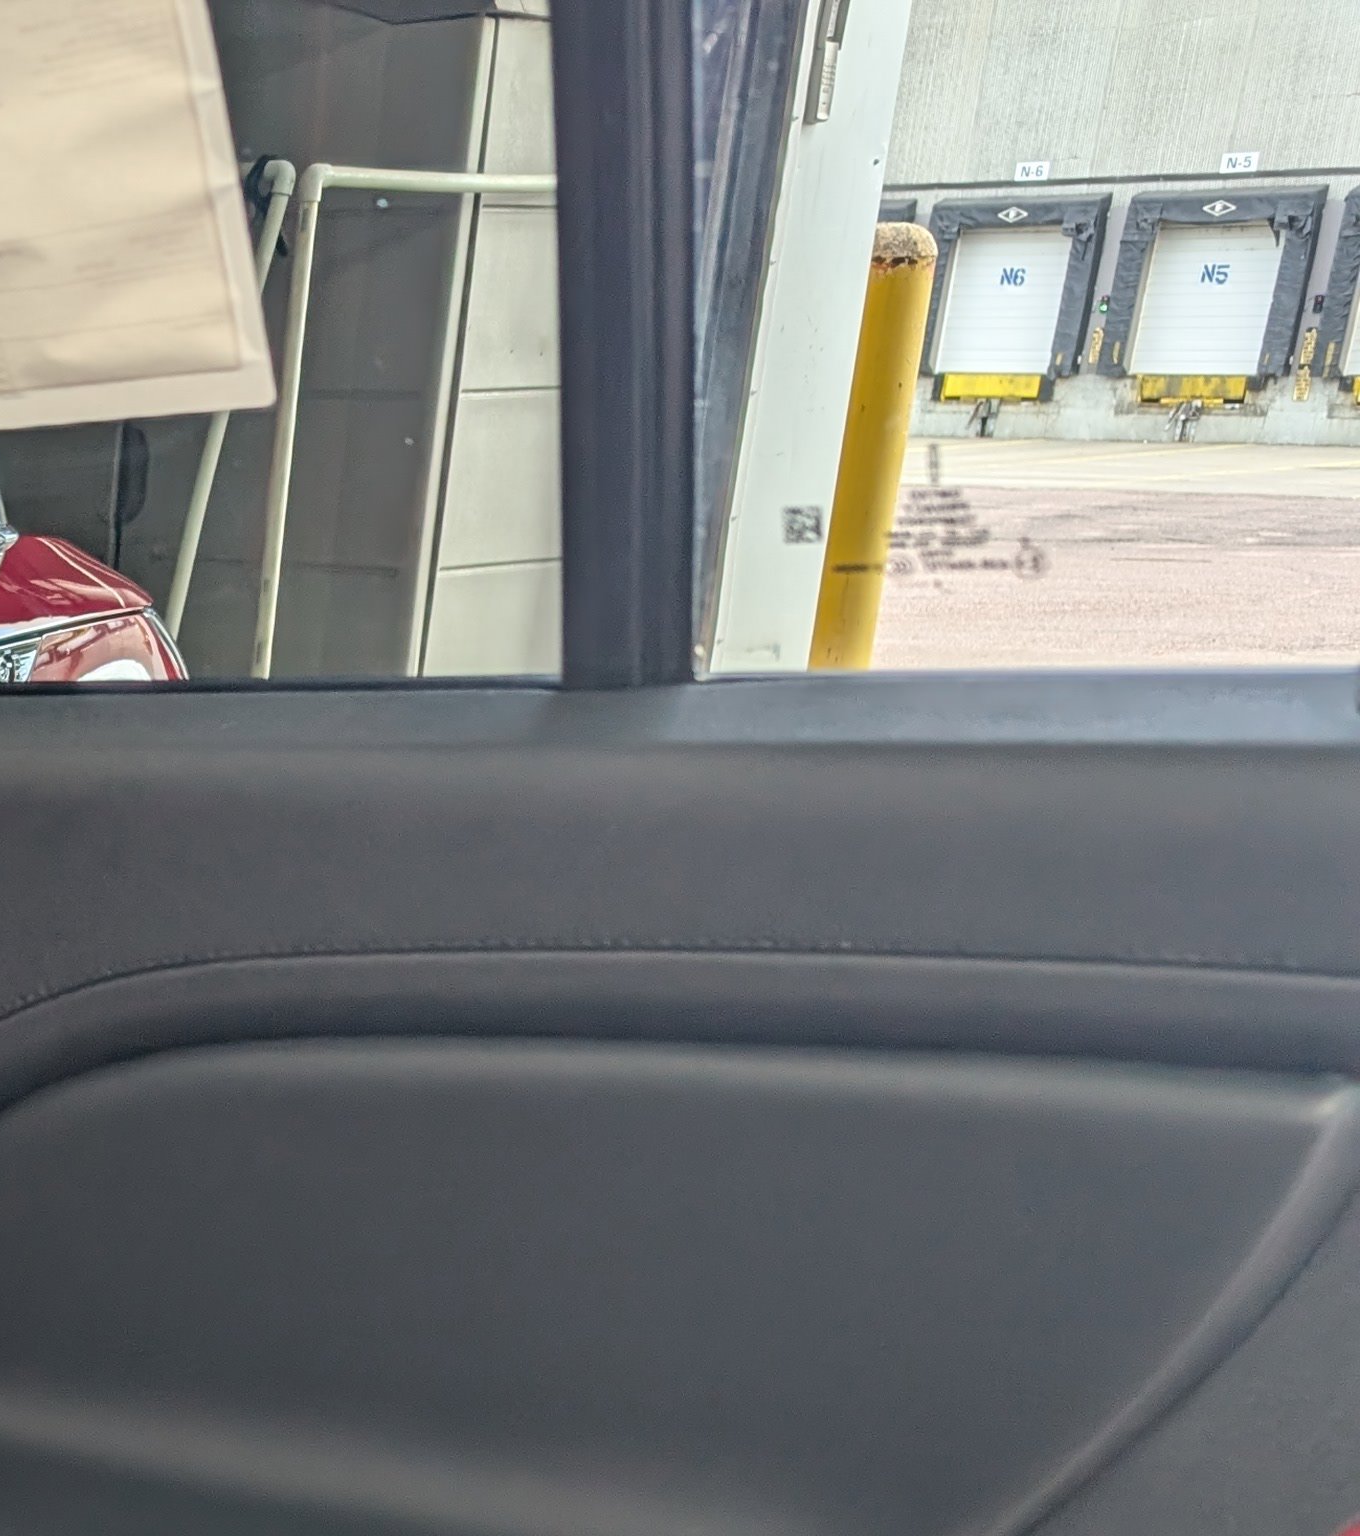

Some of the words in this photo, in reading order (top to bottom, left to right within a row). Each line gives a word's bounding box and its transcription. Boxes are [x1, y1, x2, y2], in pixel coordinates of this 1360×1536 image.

[1226, 156, 1252, 169] N-5
[1020, 165, 1043, 177] N-6
[1000, 268, 1026, 286] N6
[1201, 264, 1230, 284] N5
